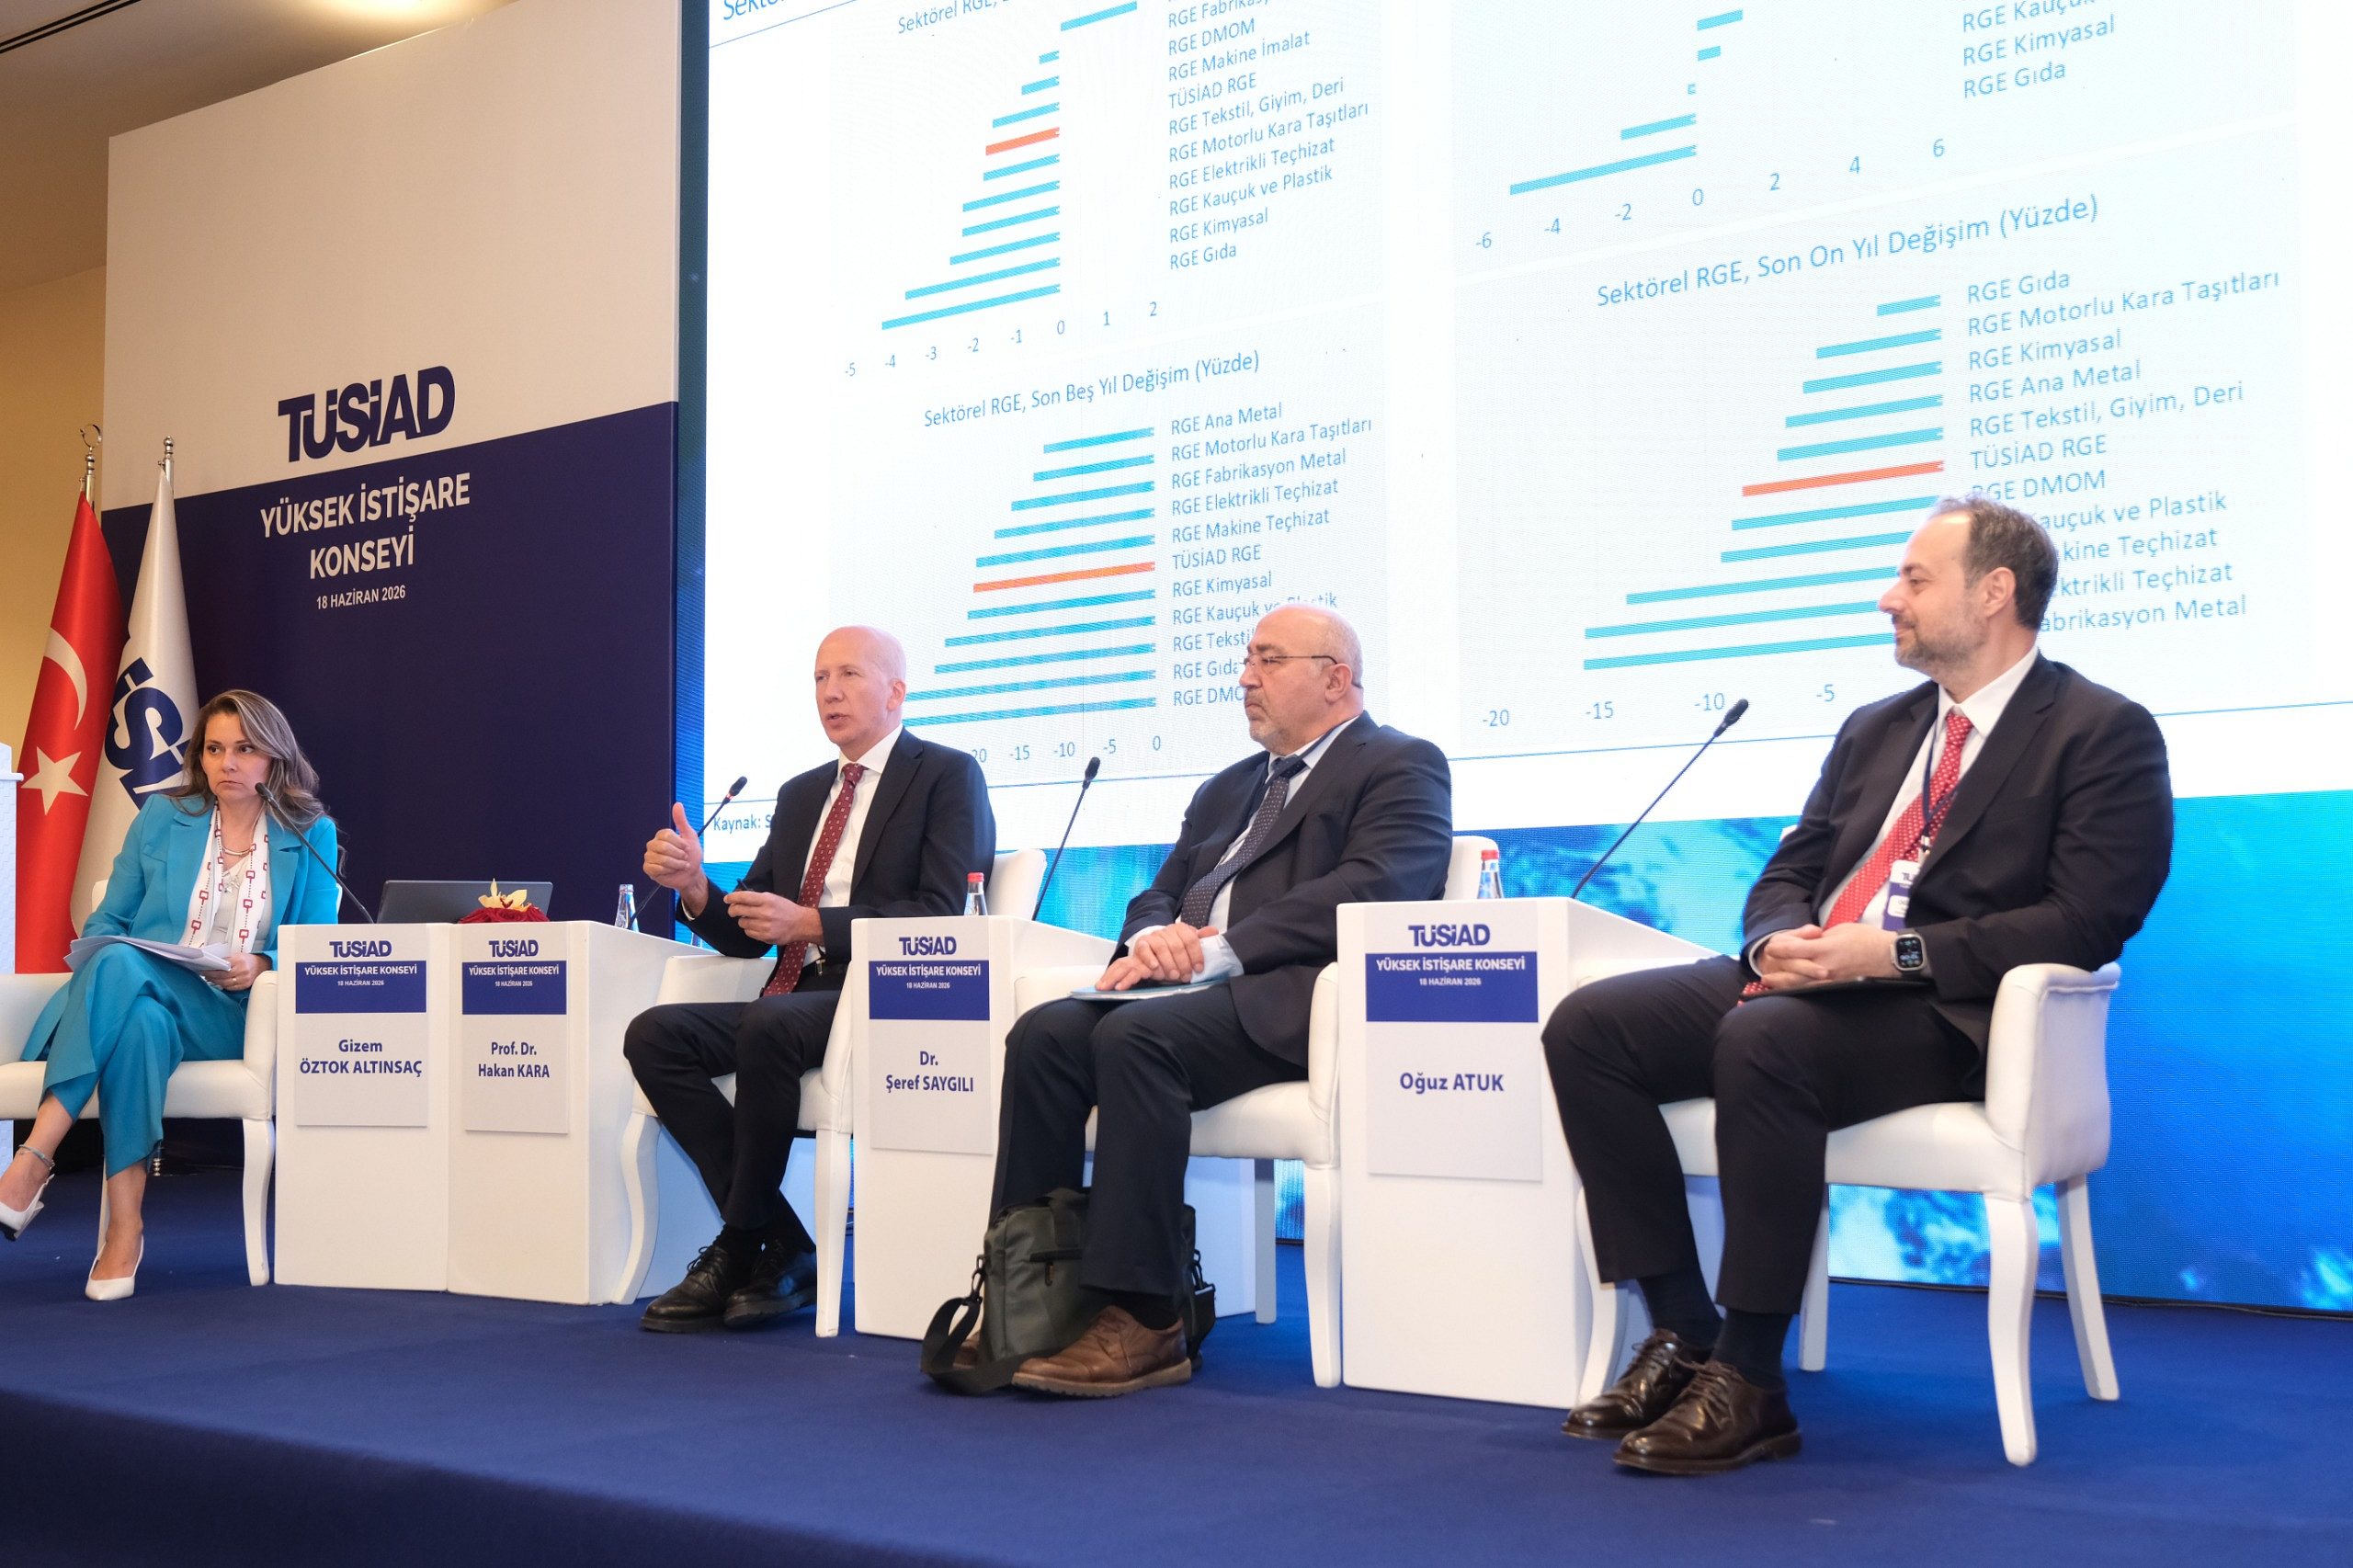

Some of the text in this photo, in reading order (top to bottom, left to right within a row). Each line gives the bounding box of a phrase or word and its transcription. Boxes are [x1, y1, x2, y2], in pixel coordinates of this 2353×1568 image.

[898, 0, 957, 34] Sektörel
[1963, 6, 2006, 32] RGE
[1169, 17, 1255, 55] RGE DMOM
[1963, 14, 2114, 66] RGE Kimyasal
[1169, 31, 1310, 81] RGE Makine İmalat
[1169, 73, 1256, 108] TÜSİAD RGE
[1964, 62, 2065, 98] RGE Gıda
[1169, 77, 1344, 134] RGE Tekstil, Giyim, Deri
[1169, 104, 1368, 162] RGE Motorlu Kara Taşıtları
[1170, 138, 1335, 188] RGE Elektrikli Teçhizat
[1170, 165, 1332, 215] RGE Kauçuk ve Plastik
[1475, 139, 1945, 249] -6 -4 -2 0 2 4 6
[1170, 207, 1267, 243] RGE Kimyasal
[1170, 243, 1236, 269] RGE Gıda
[1597, 194, 2097, 306] Sektörel RGE, Son On Yıl Değişim (Yüzde)
[1968, 270, 2070, 303] RGE Gıda
[1969, 272, 2279, 336] RGE Motorlu Kara Taşıtları
[1970, 328, 2120, 369] RGE Kimyasal
[925, 350, 1259, 426] Sektörel RGE, Son Beş Yıl Değişim (Yüzde)
[1970, 360, 2140, 403] RGE Ana Metal
[1172, 403, 1281, 435] RGE Ana Metal
[1971, 381, 2243, 437] RGE Tekstil, Giyim, Deri
[1172, 419, 1371, 461] RGE Motorlu Kara Taşıtları
[1971, 435, 2106, 470] TÜSİAD RGE
[1172, 449, 1346, 489] RGE Fabrikasyon Metal
[2024, 470, 2105, 497] DMOM
[260, 473, 471, 539] YÜKSEK İSTİŞARE
[1172, 480, 1338, 516] RGE Elektrikli Teçhizat
[2038, 492, 2226, 532] auçuk ve Plastik
[1173, 509, 1329, 542] RGE Makine Teçhizat
[310, 525, 414, 580] KONSEYİ
[1172, 544, 1260, 569] TÜSİAD RGE
[2118, 528, 2217, 557] Teçhizat
[1173, 571, 1271, 597] RGE Kimyasal
[2132, 563, 2232, 591] Teçhizat
[316, 585, 406, 610] 18 HAZİRAN 2026
[1173, 601, 1259, 625] RGE Kauçuk
[2040, 595, 2245, 634] abrikasyon Metal
[1174, 634, 1202, 652] RGE
[1174, 662, 1201, 679] RGE
[1174, 688, 1202, 706] RGE
[1483, 684, 1836, 727] -20 -15 -10 -5
[1009, 735, 1162, 761] -15 -10 -5 0
[713, 814, 761, 834] Kaynak:
[304, 963, 417, 978] YÜKSEK İSTİŞARE KONSEYİ
[469, 963, 559, 978] YÜKSEK İSTİŞARE KONSEYİ
[876, 963, 981, 978] YÜKSEK İSTİŞARE KONSEYİ
[1376, 956, 1526, 973] YÜKSEK İSTİŞARE KONSEYİ
[1429, 976, 1462, 986] HAZİRAN
[338, 1040, 383, 1052] Gizem
[491, 1041, 537, 1055] Prof. Dr.
[920, 1051, 938, 1065] Dr.
[300, 1058, 423, 1077] ÖZTOK ALTINSAÇ
[478, 1063, 550, 1078] Hakan KARA
[886, 1074, 973, 1093] Şeref SAYGILI
[1400, 1072, 1504, 1094] Oğuz ATUK
